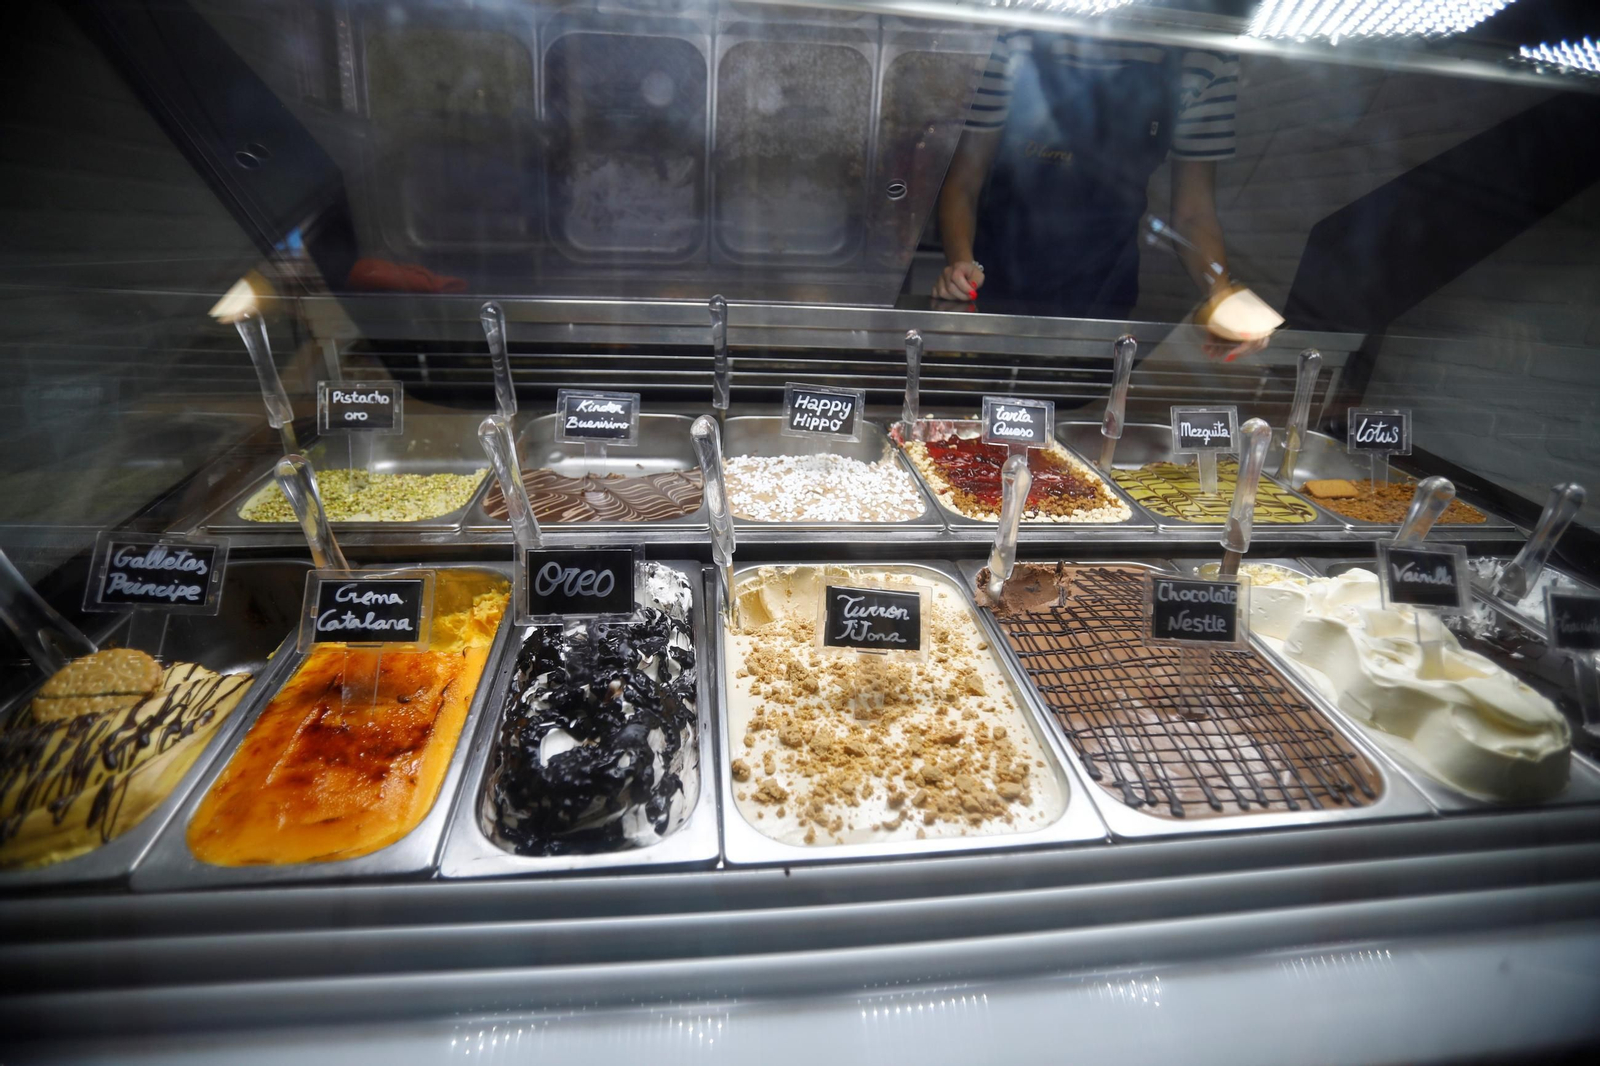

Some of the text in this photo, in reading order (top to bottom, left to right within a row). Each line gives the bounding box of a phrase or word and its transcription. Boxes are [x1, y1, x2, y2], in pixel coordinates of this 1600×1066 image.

[333, 390, 390, 404] Pistacho
[576, 399, 625, 414] Kinder
[794, 394, 852, 419] Happy
[344, 411, 368, 421] oro
[792, 412, 843, 431] Hippo
[992, 421, 1034, 437] Queso
[1180, 420, 1231, 445] Mezquita
[113, 545, 208, 575] Galletas
[534, 561, 615, 598] Oreo
[1391, 561, 1454, 587] Vainilla
[106, 572, 202, 602] Principe
[335, 583, 404, 605] Crema
[1157, 582, 1238, 605] Chocolate
[836, 594, 910, 621] Turron
[316, 608, 413, 632] Catalana
[1167, 609, 1227, 633] Nestle
